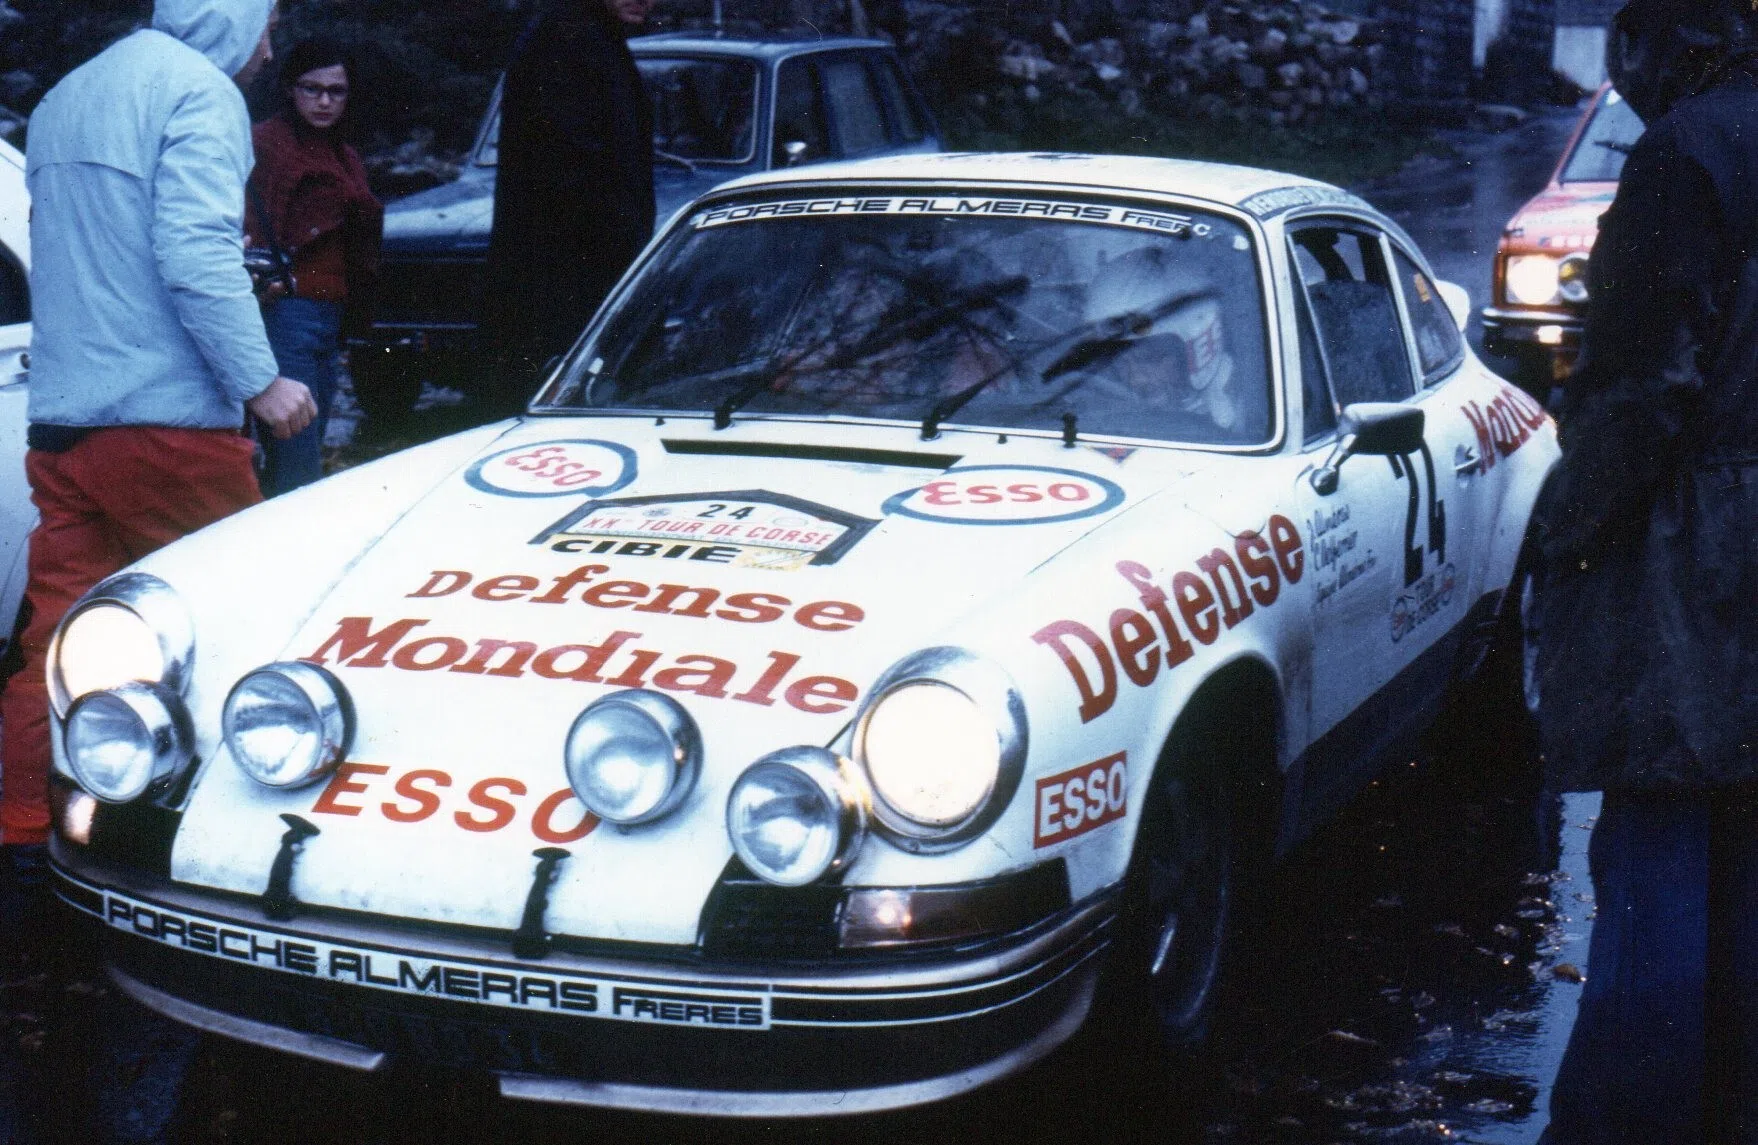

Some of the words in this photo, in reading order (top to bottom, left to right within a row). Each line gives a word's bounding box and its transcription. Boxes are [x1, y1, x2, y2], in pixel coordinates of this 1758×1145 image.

[702, 198, 889, 227] PORSCHE
[901, 199, 1112, 219] ALMERAS
[505, 446, 602, 486] Esso
[921, 481, 1091, 505] Esso
[637, 519, 705, 533] TOUR
[706, 523, 744, 536] DE
[745, 526, 834, 545] CORSE
[697, 503, 756, 520] 24
[550, 539, 743, 564] CIBIE
[404, 563, 866, 632] Defense
[1031, 514, 1304, 724] Defense
[296, 616, 859, 714] Mondiale
[312, 761, 601, 843] ESSO
[1038, 756, 1127, 840] ESSO
[107, 895, 320, 974] PORSCHE
[329, 950, 598, 1012] ALMERAS
[613, 986, 763, 1026] FRERES
